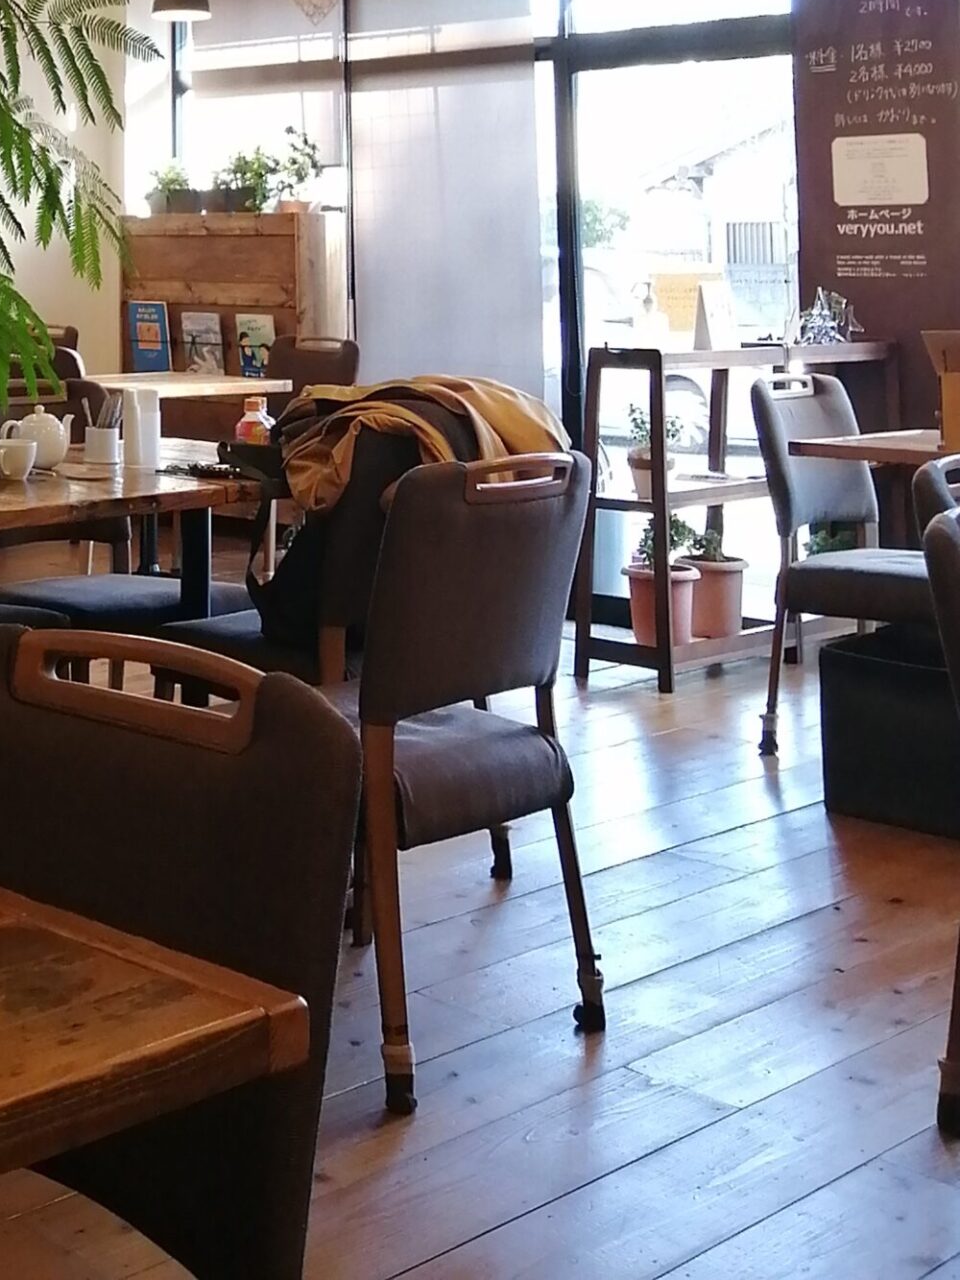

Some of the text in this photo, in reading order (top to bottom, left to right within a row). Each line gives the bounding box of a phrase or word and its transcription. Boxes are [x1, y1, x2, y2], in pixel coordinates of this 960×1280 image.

[847, 207, 912, 221] ホームページ
[836, 220, 925, 239] veryyou.net
